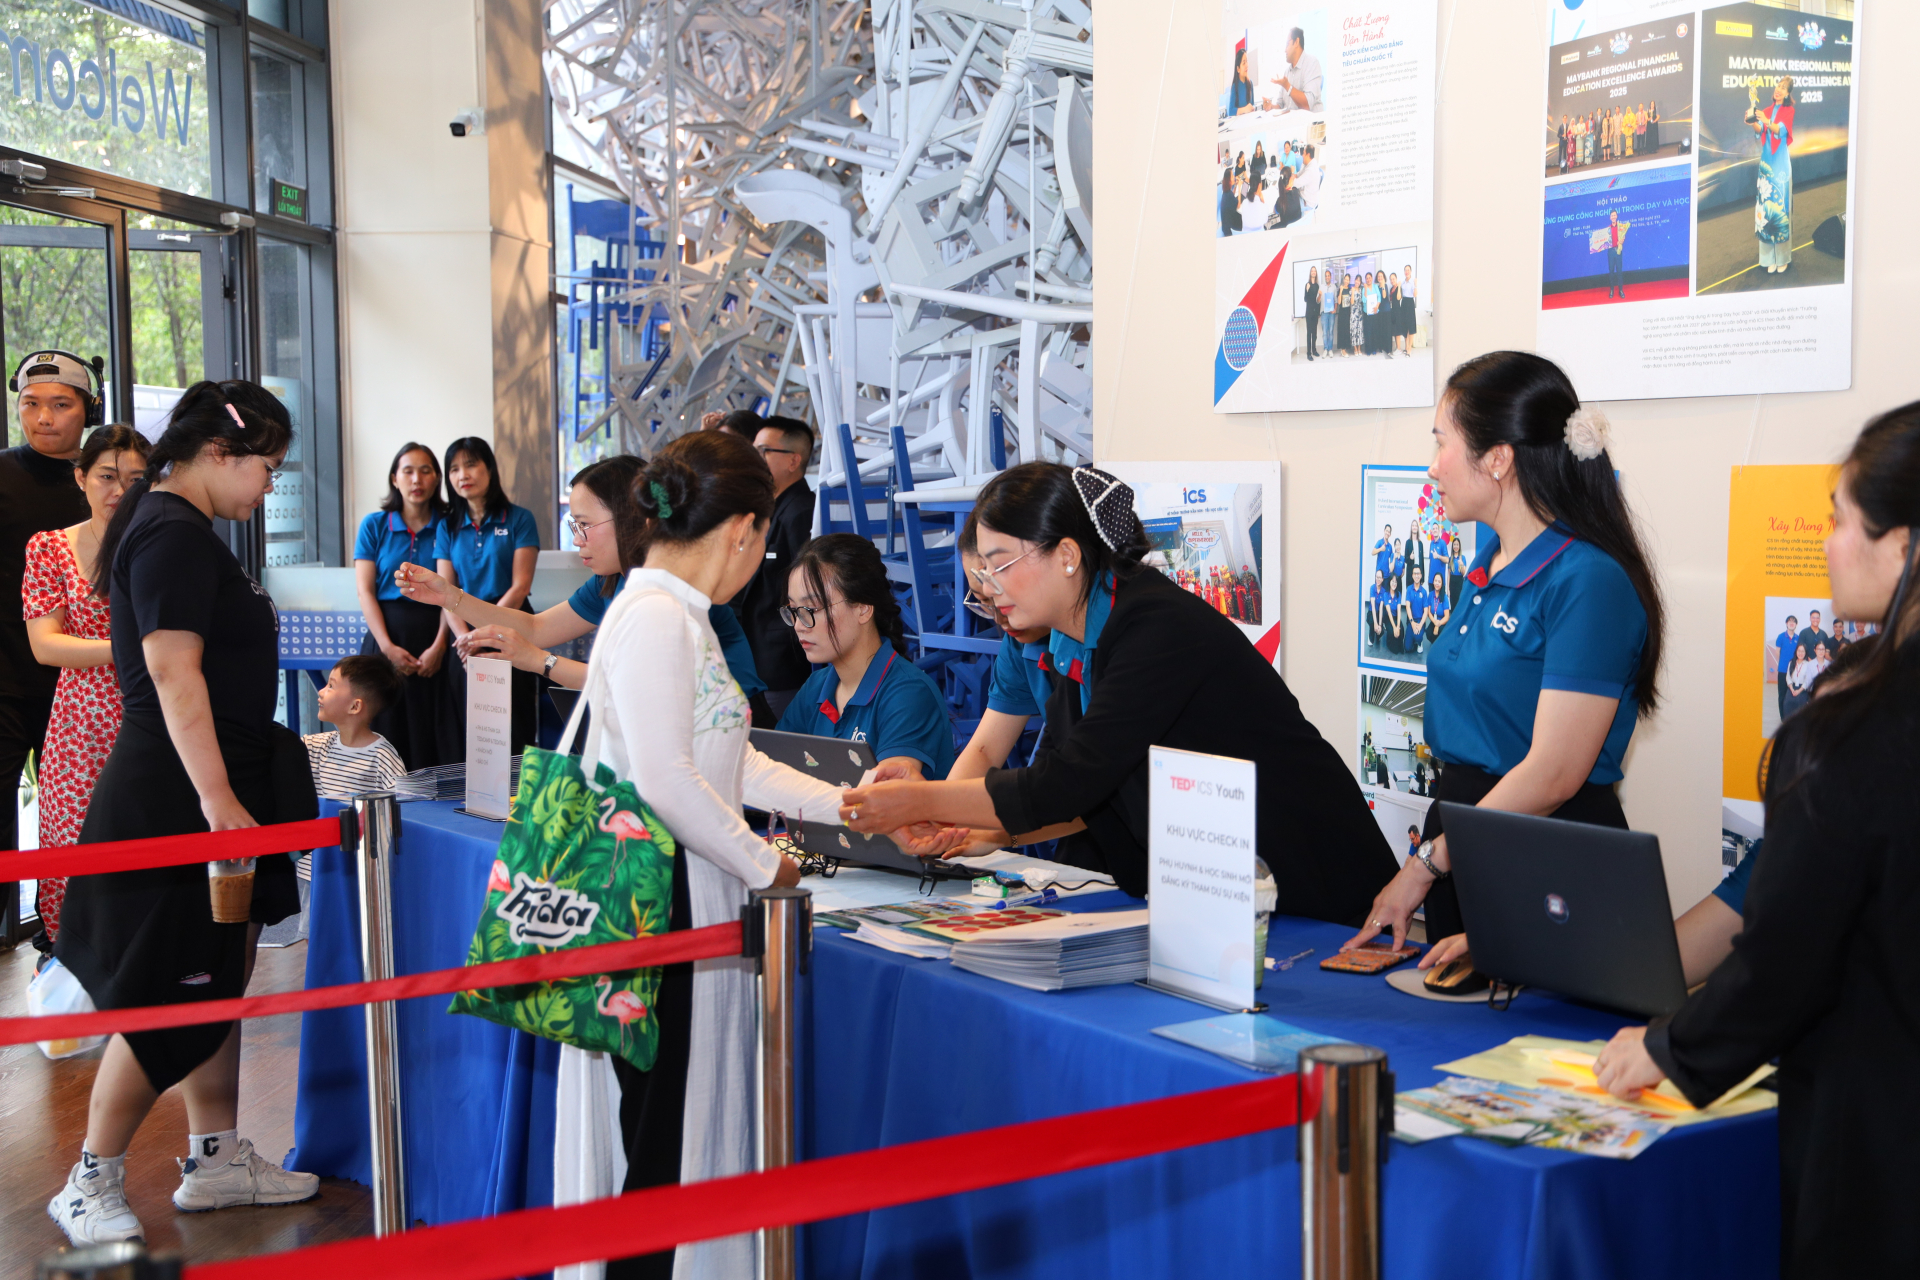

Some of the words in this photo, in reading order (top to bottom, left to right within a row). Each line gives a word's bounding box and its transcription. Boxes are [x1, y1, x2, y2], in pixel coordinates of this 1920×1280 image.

[1566, 68, 1600, 84] MAYBANK
[1601, 60, 1636, 76] REGIONAL
[1638, 51, 1679, 68] FINANCIAL
[1728, 56, 1787, 71] MAYBANK
[1788, 59, 1832, 72] REGIONAL
[1563, 80, 1601, 97] EDUCATION
[1602, 71, 1646, 88] EXCELLENCE
[1647, 63, 1683, 78] AWARDS
[1610, 87, 1627, 98] 2025
[1801, 91, 1822, 103] 2025
[282, 186, 298, 201] EXIT
[1597, 197, 1608, 206] HỘI
[1609, 195, 1628, 205] THẢO
[1558, 214, 1574, 223] DỤNG
[1576, 211, 1593, 219] CÔNG
[1622, 203, 1644, 213] TRONG
[1662, 198, 1672, 207] VÀ
[1674, 197, 1689, 206] HỌC
[1768, 517, 1789, 534] Xây
[1794, 517, 1823, 535] Dựng
[494, 675, 505, 685] Youth
[1197, 780, 1212, 796] ICS
[1216, 783, 1245, 801] Youth
[1167, 824, 1185, 837] KHU
[1187, 827, 1205, 843] VỰC
[1207, 832, 1238, 848] CHECK
[1240, 838, 1249, 849] IN
[1159, 857, 1173, 868] PHỤ
[1174, 861, 1198, 872] HUYNH
[1199, 866, 1203, 874] &
[1205, 867, 1220, 878] HỌC
[1221, 870, 1237, 881] SINH
[1191, 881, 1209, 893] THAM
